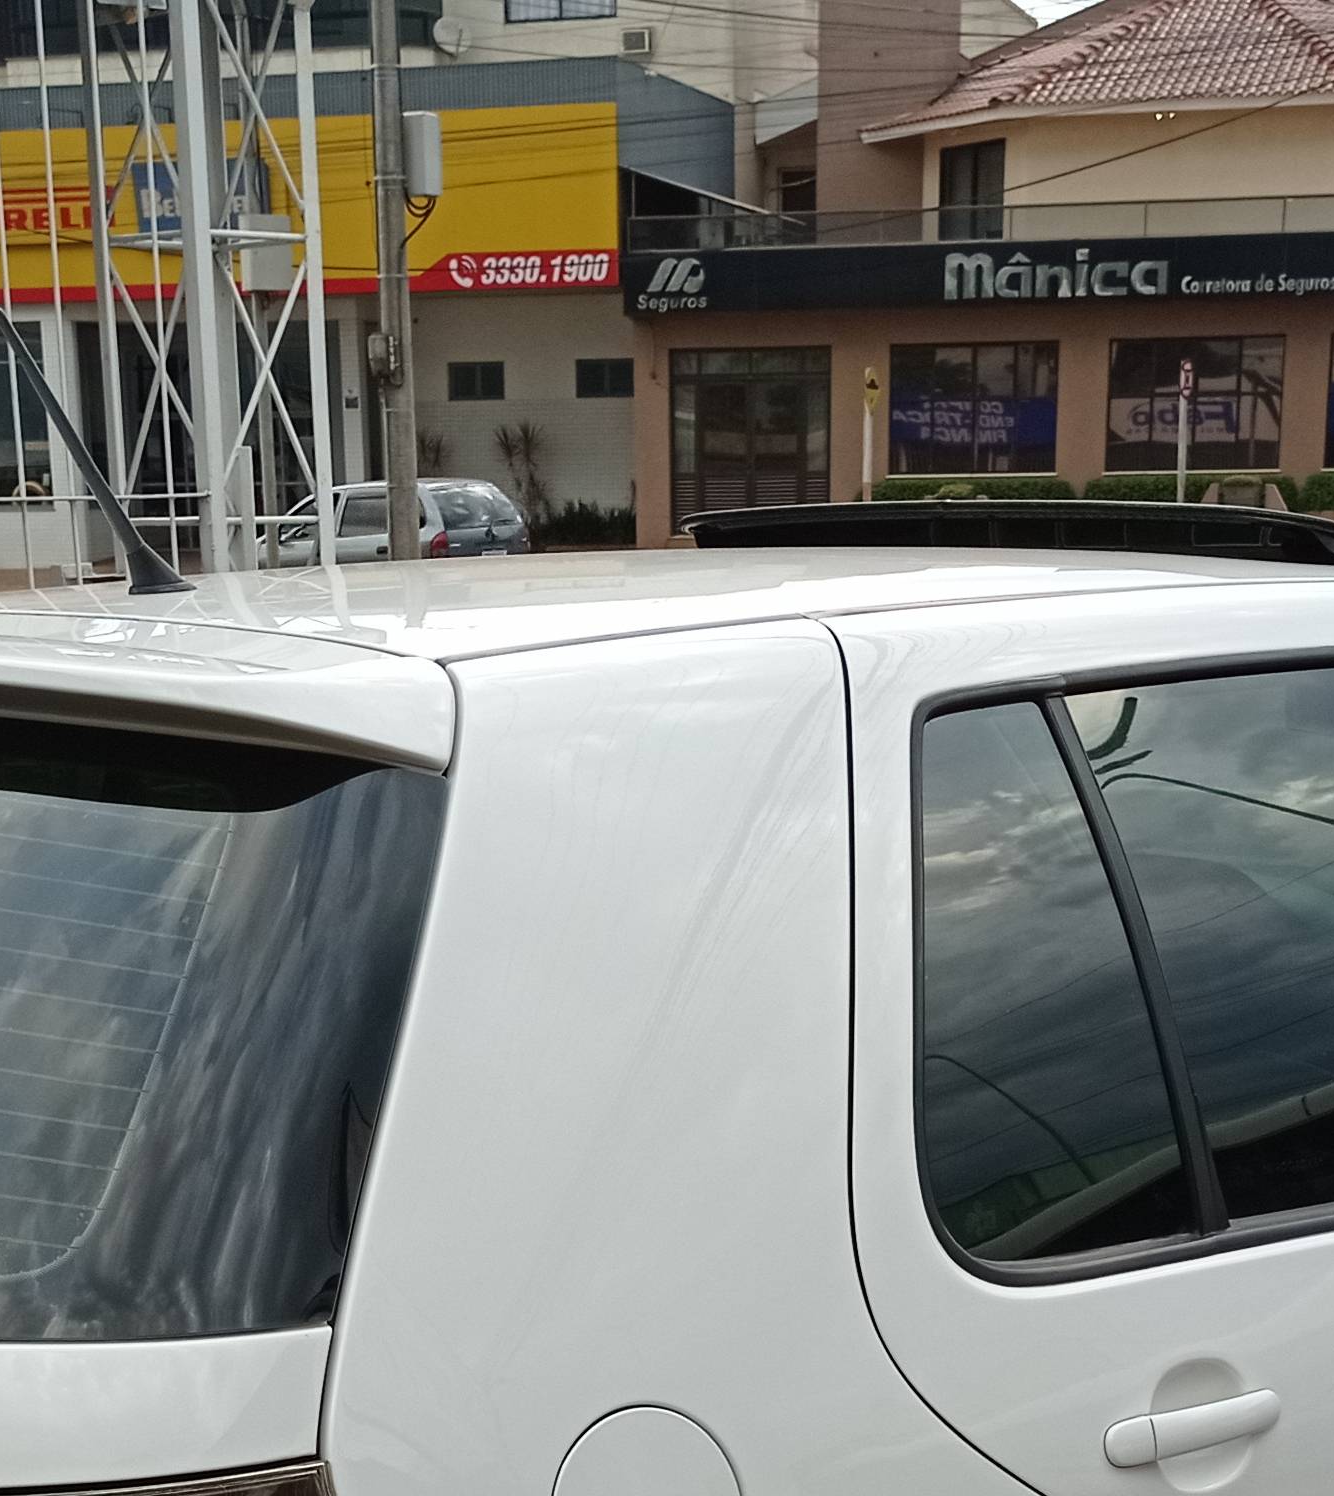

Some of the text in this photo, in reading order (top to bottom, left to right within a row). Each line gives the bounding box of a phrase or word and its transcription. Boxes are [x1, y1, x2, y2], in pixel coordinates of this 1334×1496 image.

[480, 253, 610, 285] 3330.1900
[1181, 276, 1251, 294] Corretora
[1255, 273, 1274, 293] de
[637, 295, 708, 312] Seguros
